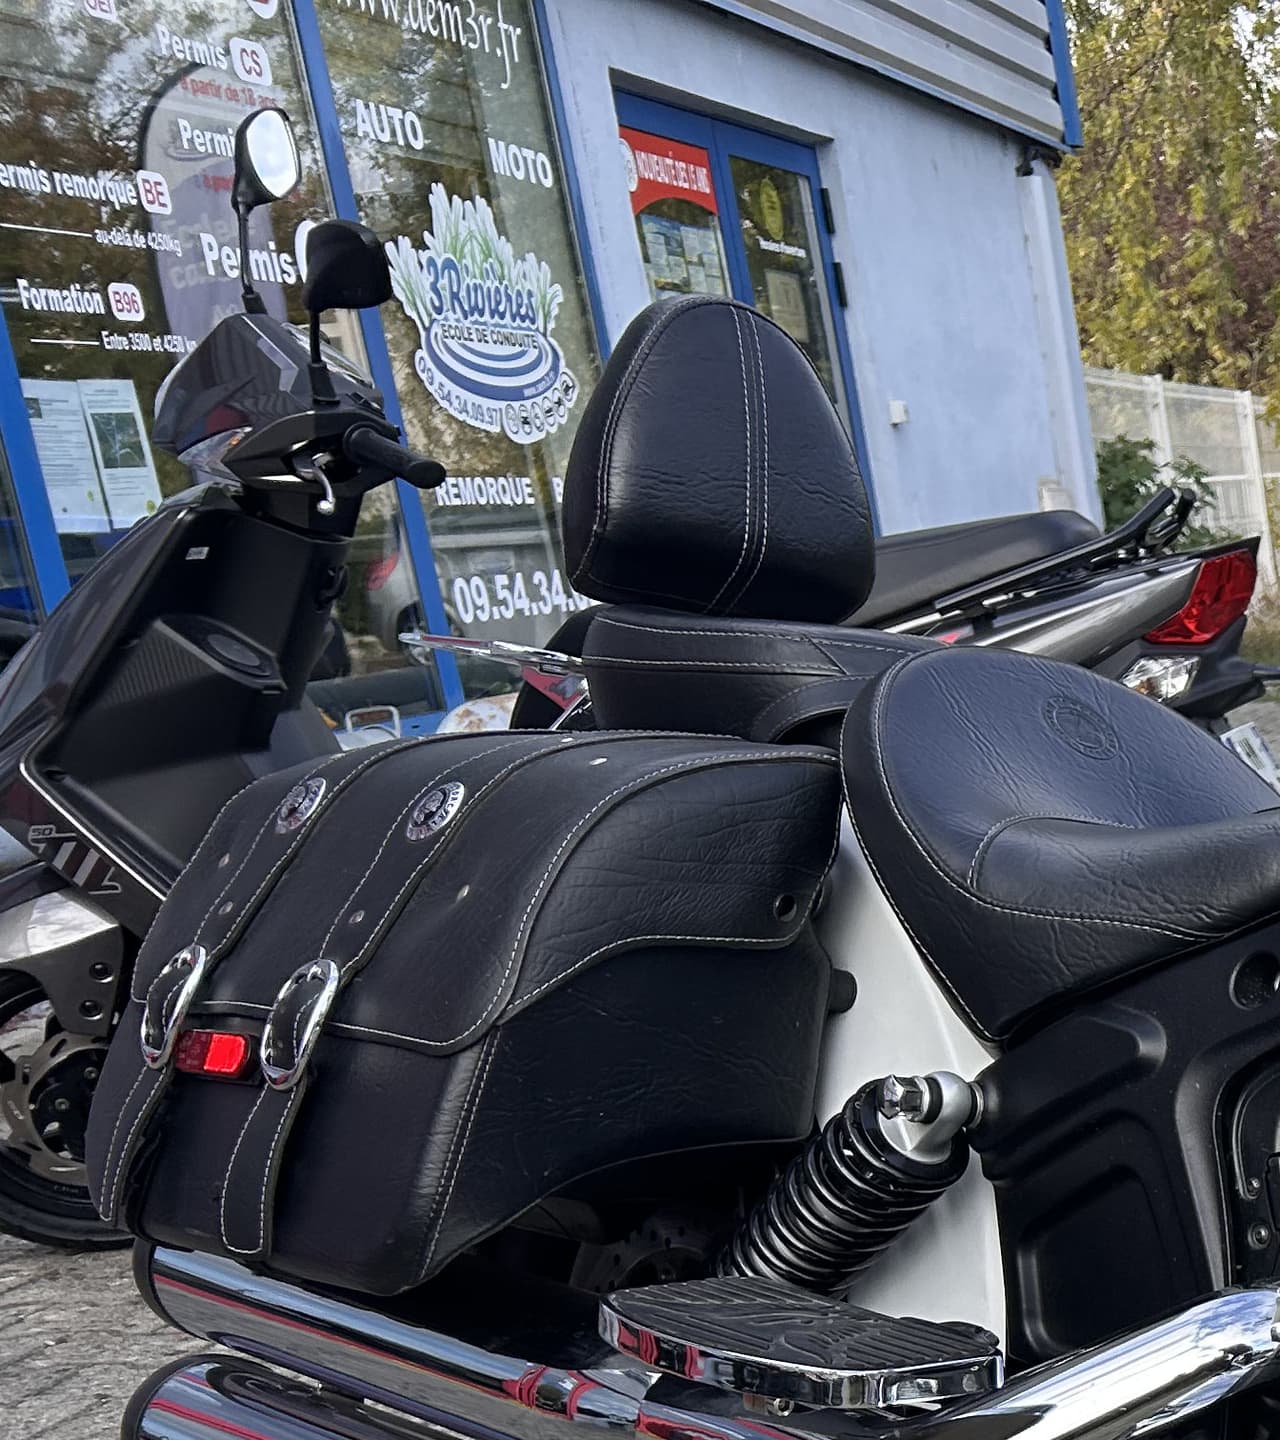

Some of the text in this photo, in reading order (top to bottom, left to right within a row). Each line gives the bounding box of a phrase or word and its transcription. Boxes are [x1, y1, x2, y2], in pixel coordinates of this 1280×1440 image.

[155, 23, 264, 78] Permis CS
[177, 117, 236, 159] Permi
[355, 99, 425, 151] AUTO
[0, 160, 51, 193] ermis
[52, 170, 137, 211] remorque
[141, 180, 169, 209] BE
[488, 137, 554, 188] MOTO
[200, 232, 297, 285] Pemis
[16, 277, 141, 315] Formation B96
[101, 330, 130, 350] Entre
[475, 327, 490, 345] DE
[489, 330, 539, 350] CONDUITE
[435, 476, 536, 507] REMORQUE
